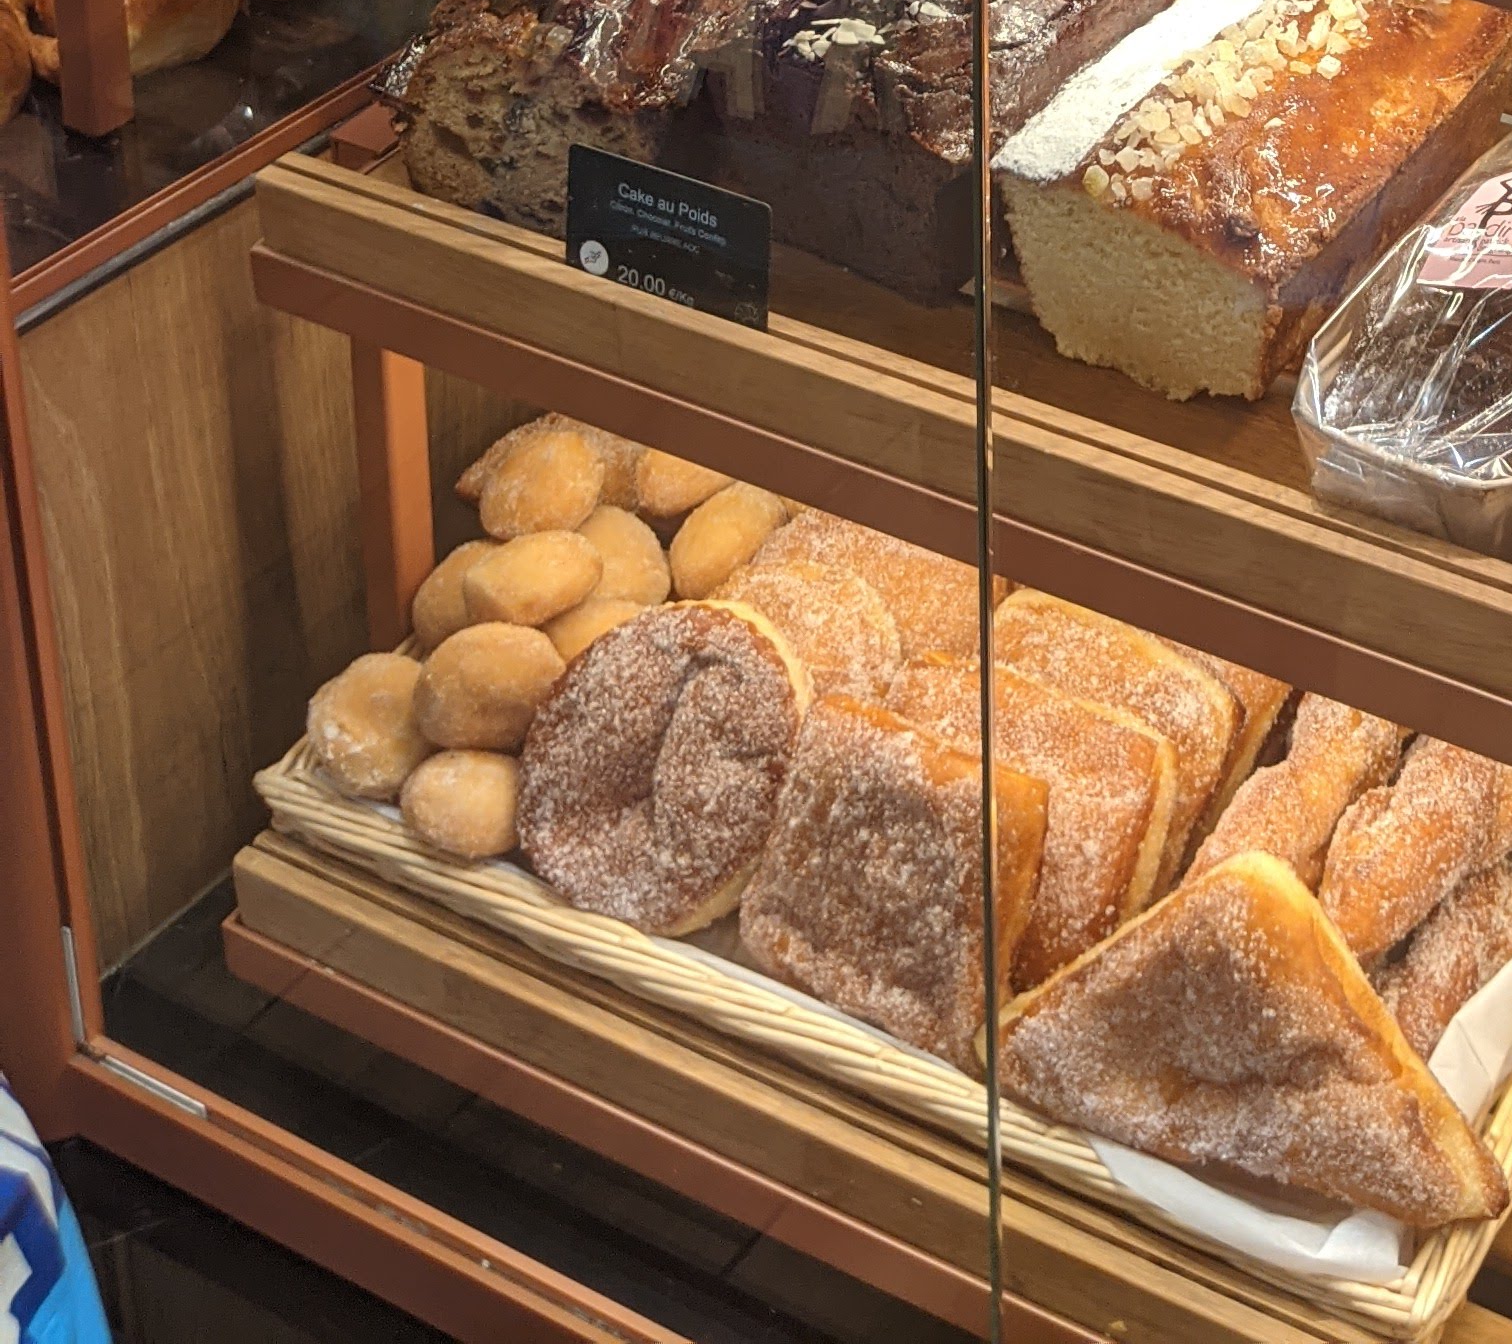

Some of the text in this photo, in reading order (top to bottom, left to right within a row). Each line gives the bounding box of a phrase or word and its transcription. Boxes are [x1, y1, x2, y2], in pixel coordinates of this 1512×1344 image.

[618, 183, 718, 228] Cake au Poids
